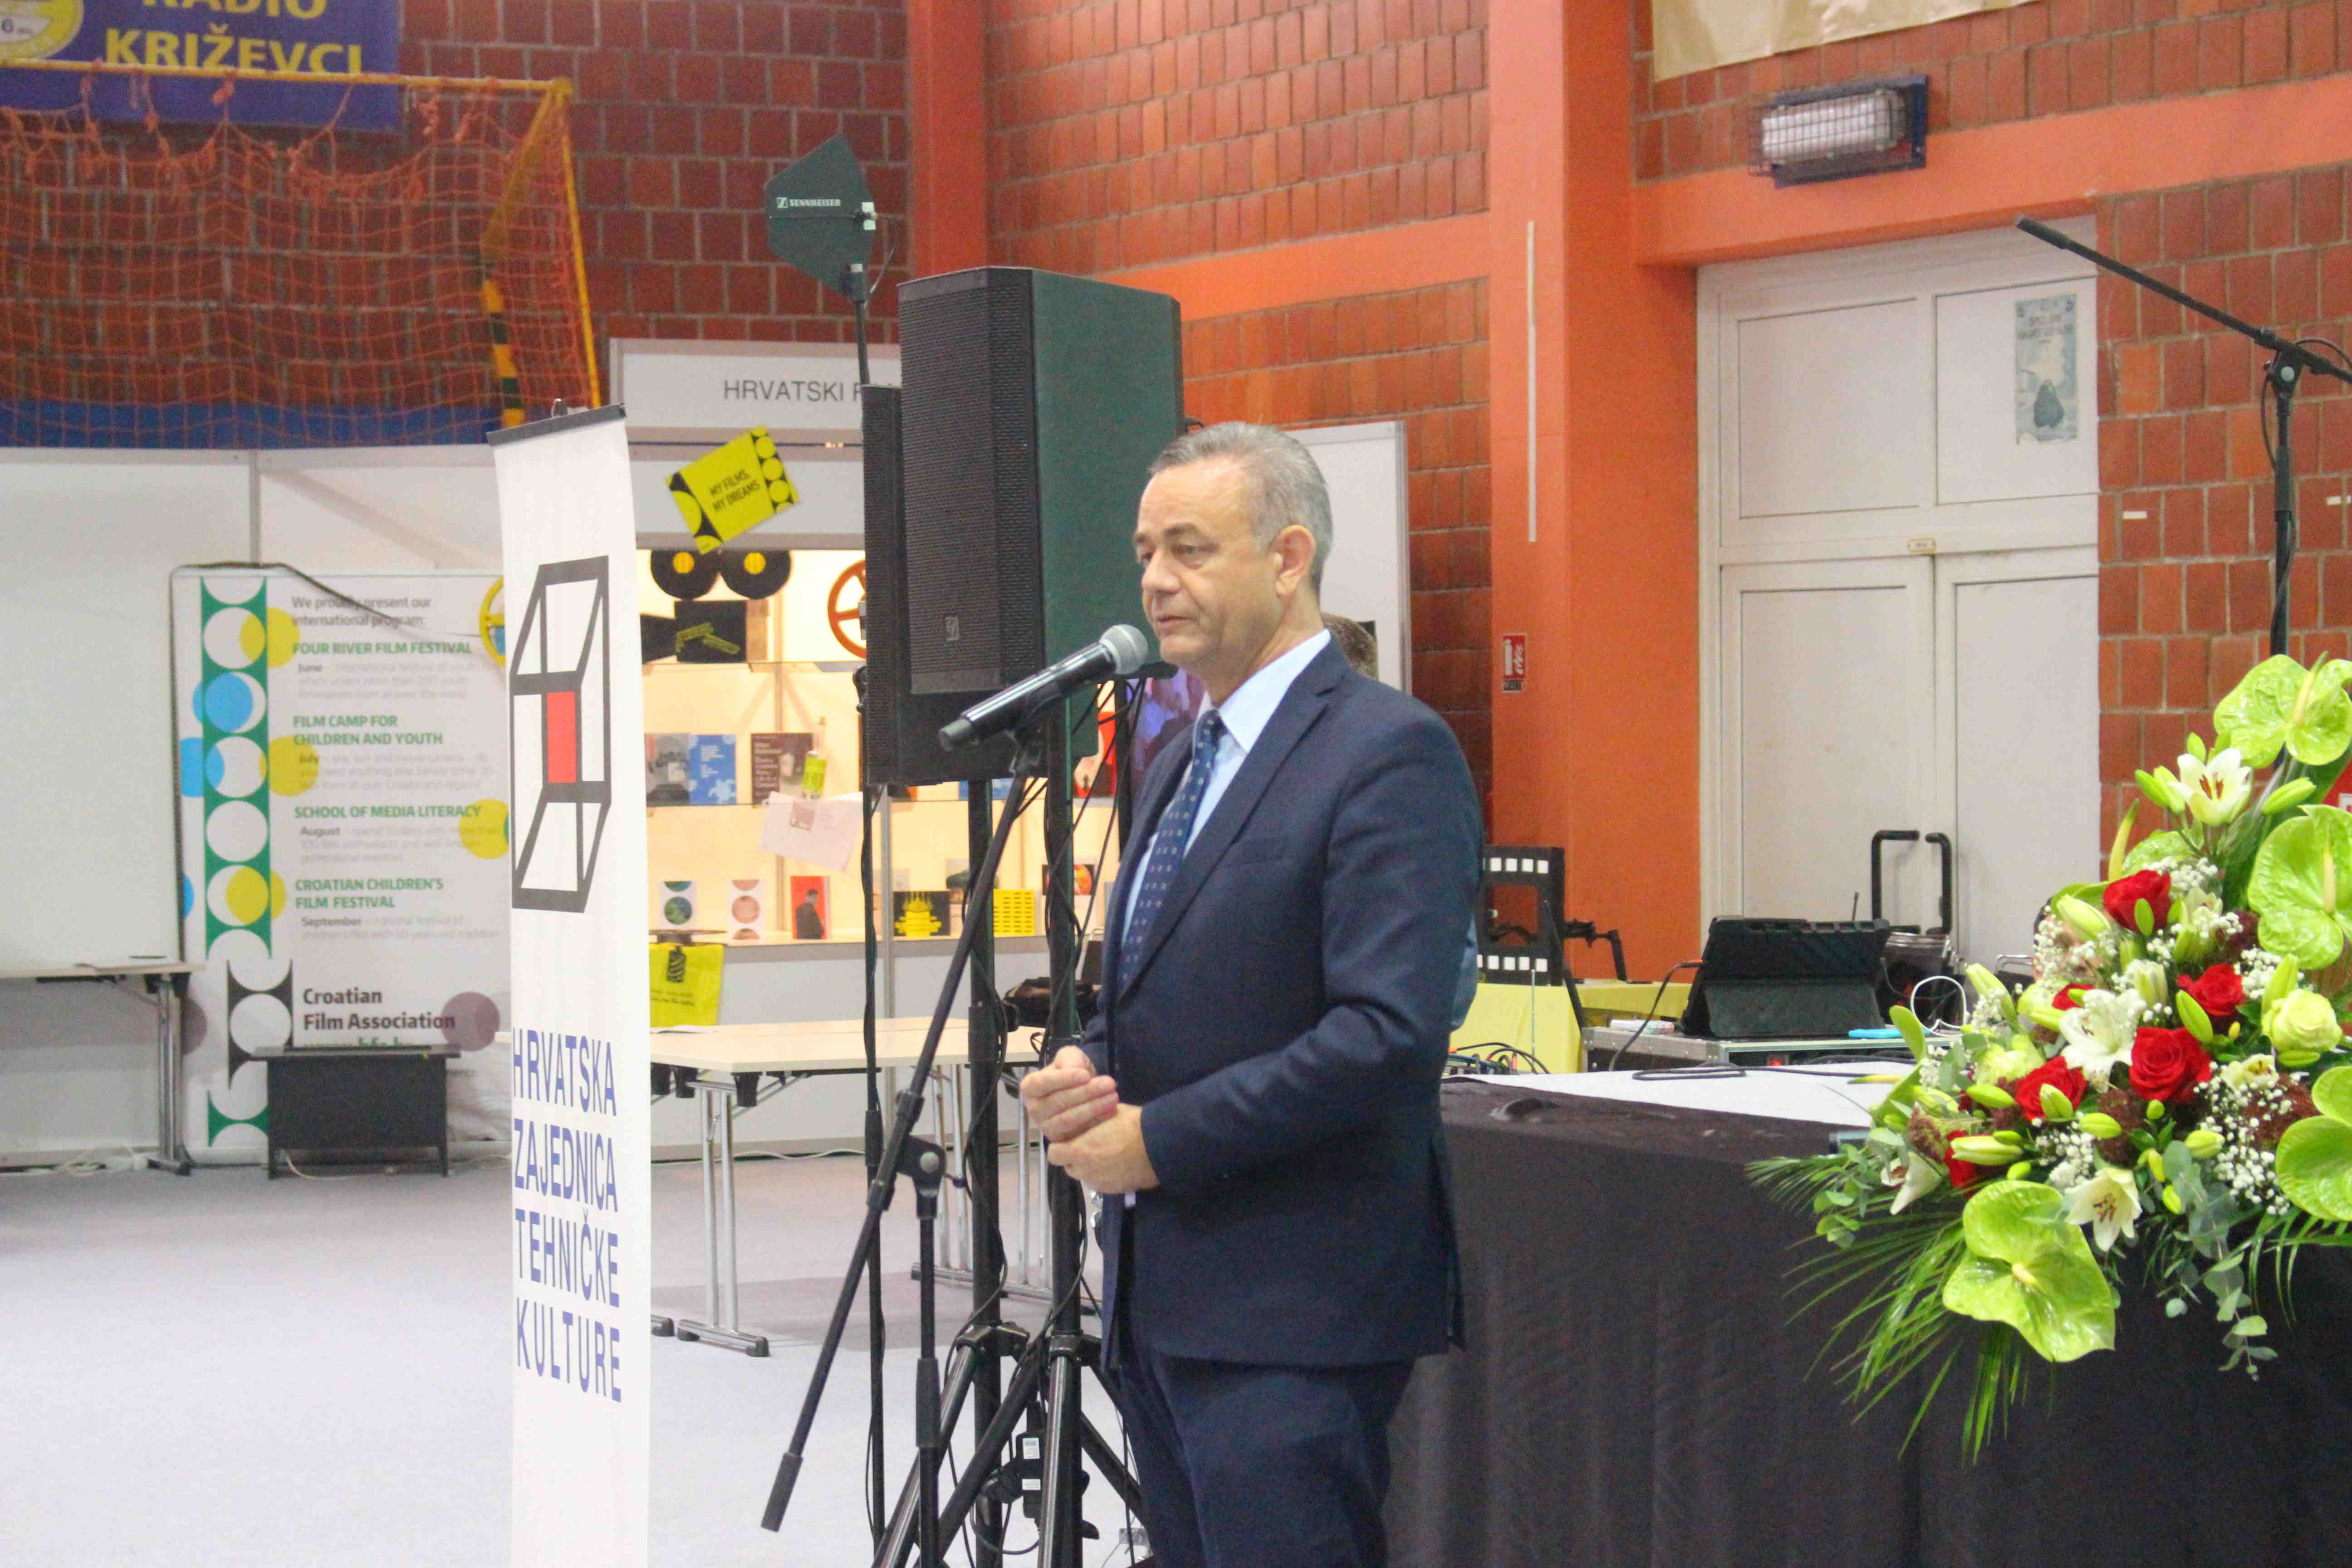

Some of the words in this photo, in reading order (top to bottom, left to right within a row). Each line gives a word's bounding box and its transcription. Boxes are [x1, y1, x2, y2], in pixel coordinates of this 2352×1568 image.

[106, 22, 362, 74] KRIŽEVCI
[724, 380, 843, 401] HRVATSKI
[292, 597, 312, 608] We
[363, 598, 407, 611] present
[412, 599, 431, 608] our
[292, 613, 369, 627] international
[293, 643, 330, 654] FOUR
[333, 643, 372, 654] RIVER
[375, 642, 407, 654] FILM
[411, 642, 472, 654] FESTIVAL
[298, 664, 323, 673] June
[293, 715, 325, 727] FILM
[328, 715, 368, 727] CAMP
[371, 715, 397, 726] FOR
[294, 734, 359, 745] CHILDREN
[363, 733, 392, 745] AND
[396, 733, 443, 745] YOUTH
[299, 754, 319, 765] July
[294, 806, 347, 818] SCHOOL
[349, 806, 367, 818] OF
[370, 806, 415, 817] MEDIA
[418, 805, 482, 817] LITERACY
[300, 826, 340, 838] August
[295, 879, 363, 892] CROATIAN
[367, 878, 443, 891] CHILDREN'S
[295, 897, 328, 909] FILM
[333, 896, 396, 908] FESTIVAL
[301, 916, 362, 928] September
[303, 987, 382, 1004] Croatian
[304, 1013, 343, 1030] Film
[348, 1012, 456, 1029] Association
[513, 1027, 617, 1116] HRVATSKA
[514, 1118, 618, 1212] ZAJEDNICA
[515, 1208, 620, 1308] TEHNIČKE
[517, 1297, 622, 1403] KULTURE
